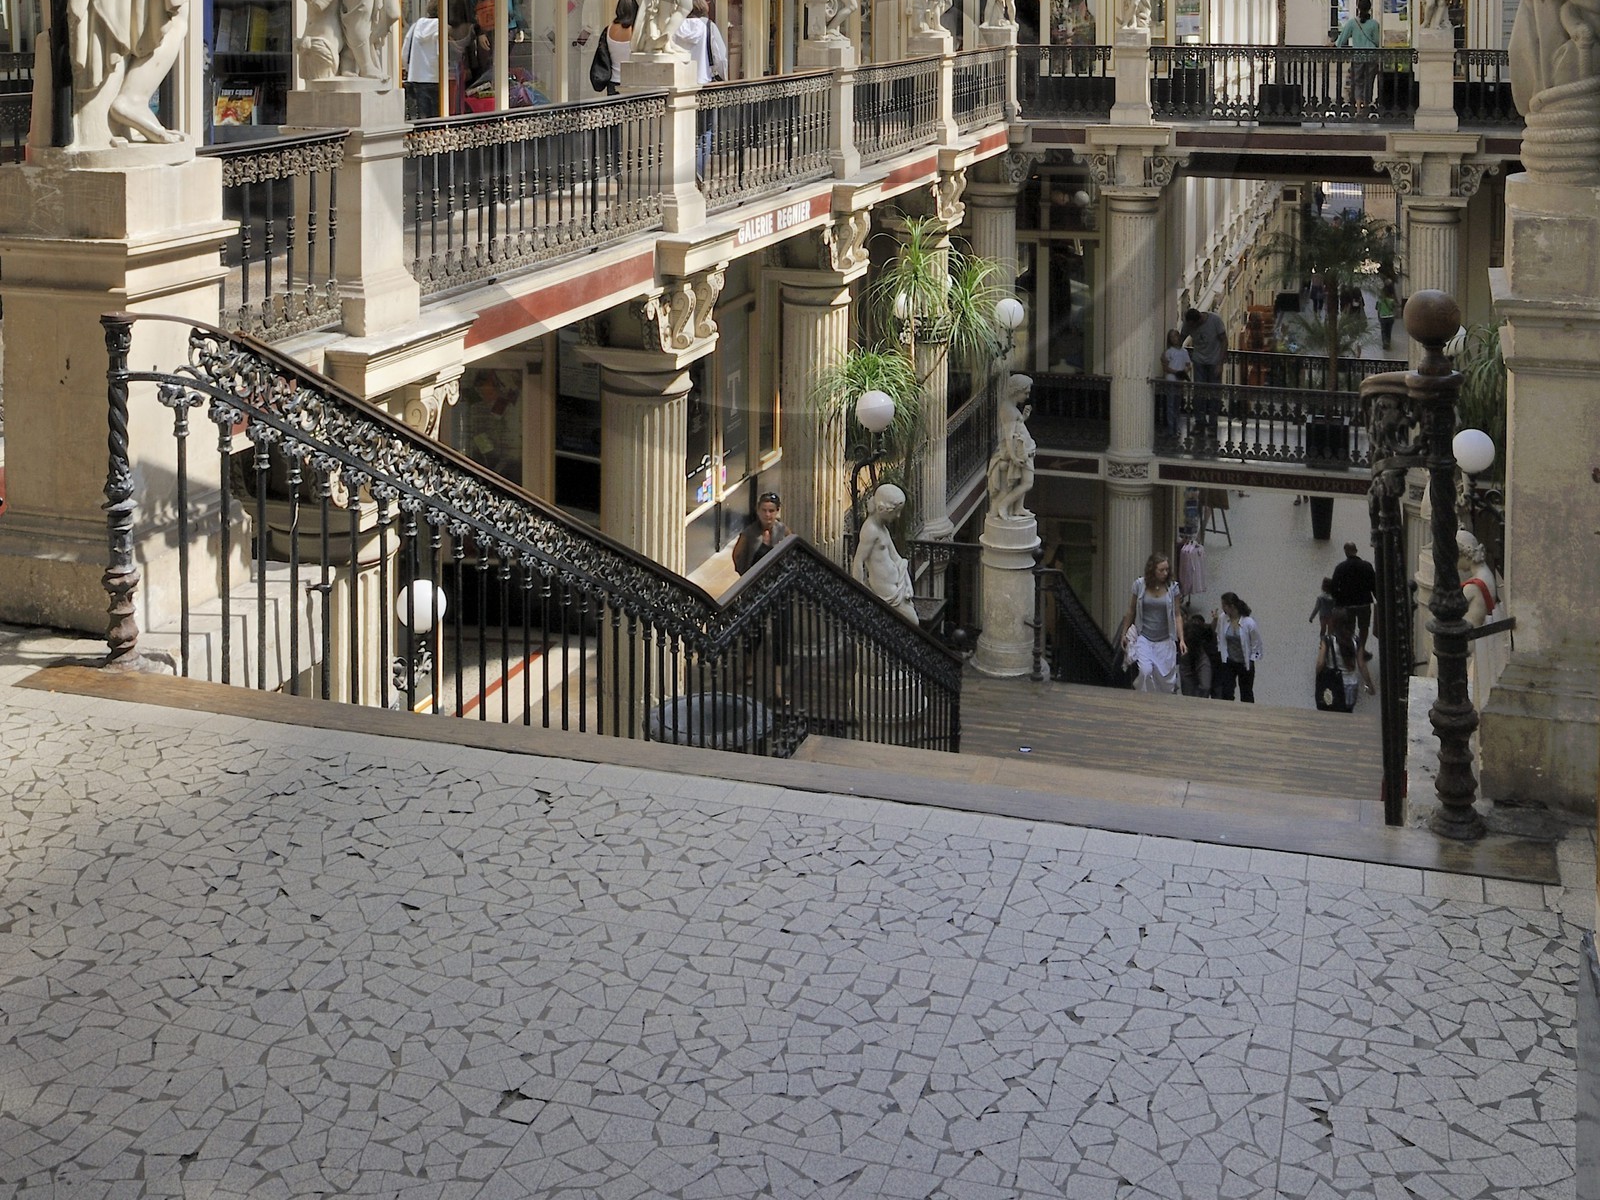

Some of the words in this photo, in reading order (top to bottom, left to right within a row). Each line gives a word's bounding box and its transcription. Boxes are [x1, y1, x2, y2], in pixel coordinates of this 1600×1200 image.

[738, 213, 773, 245] GALERIE
[777, 200, 811, 230] REGNIER
[1190, 470, 1247, 484] NATURE
